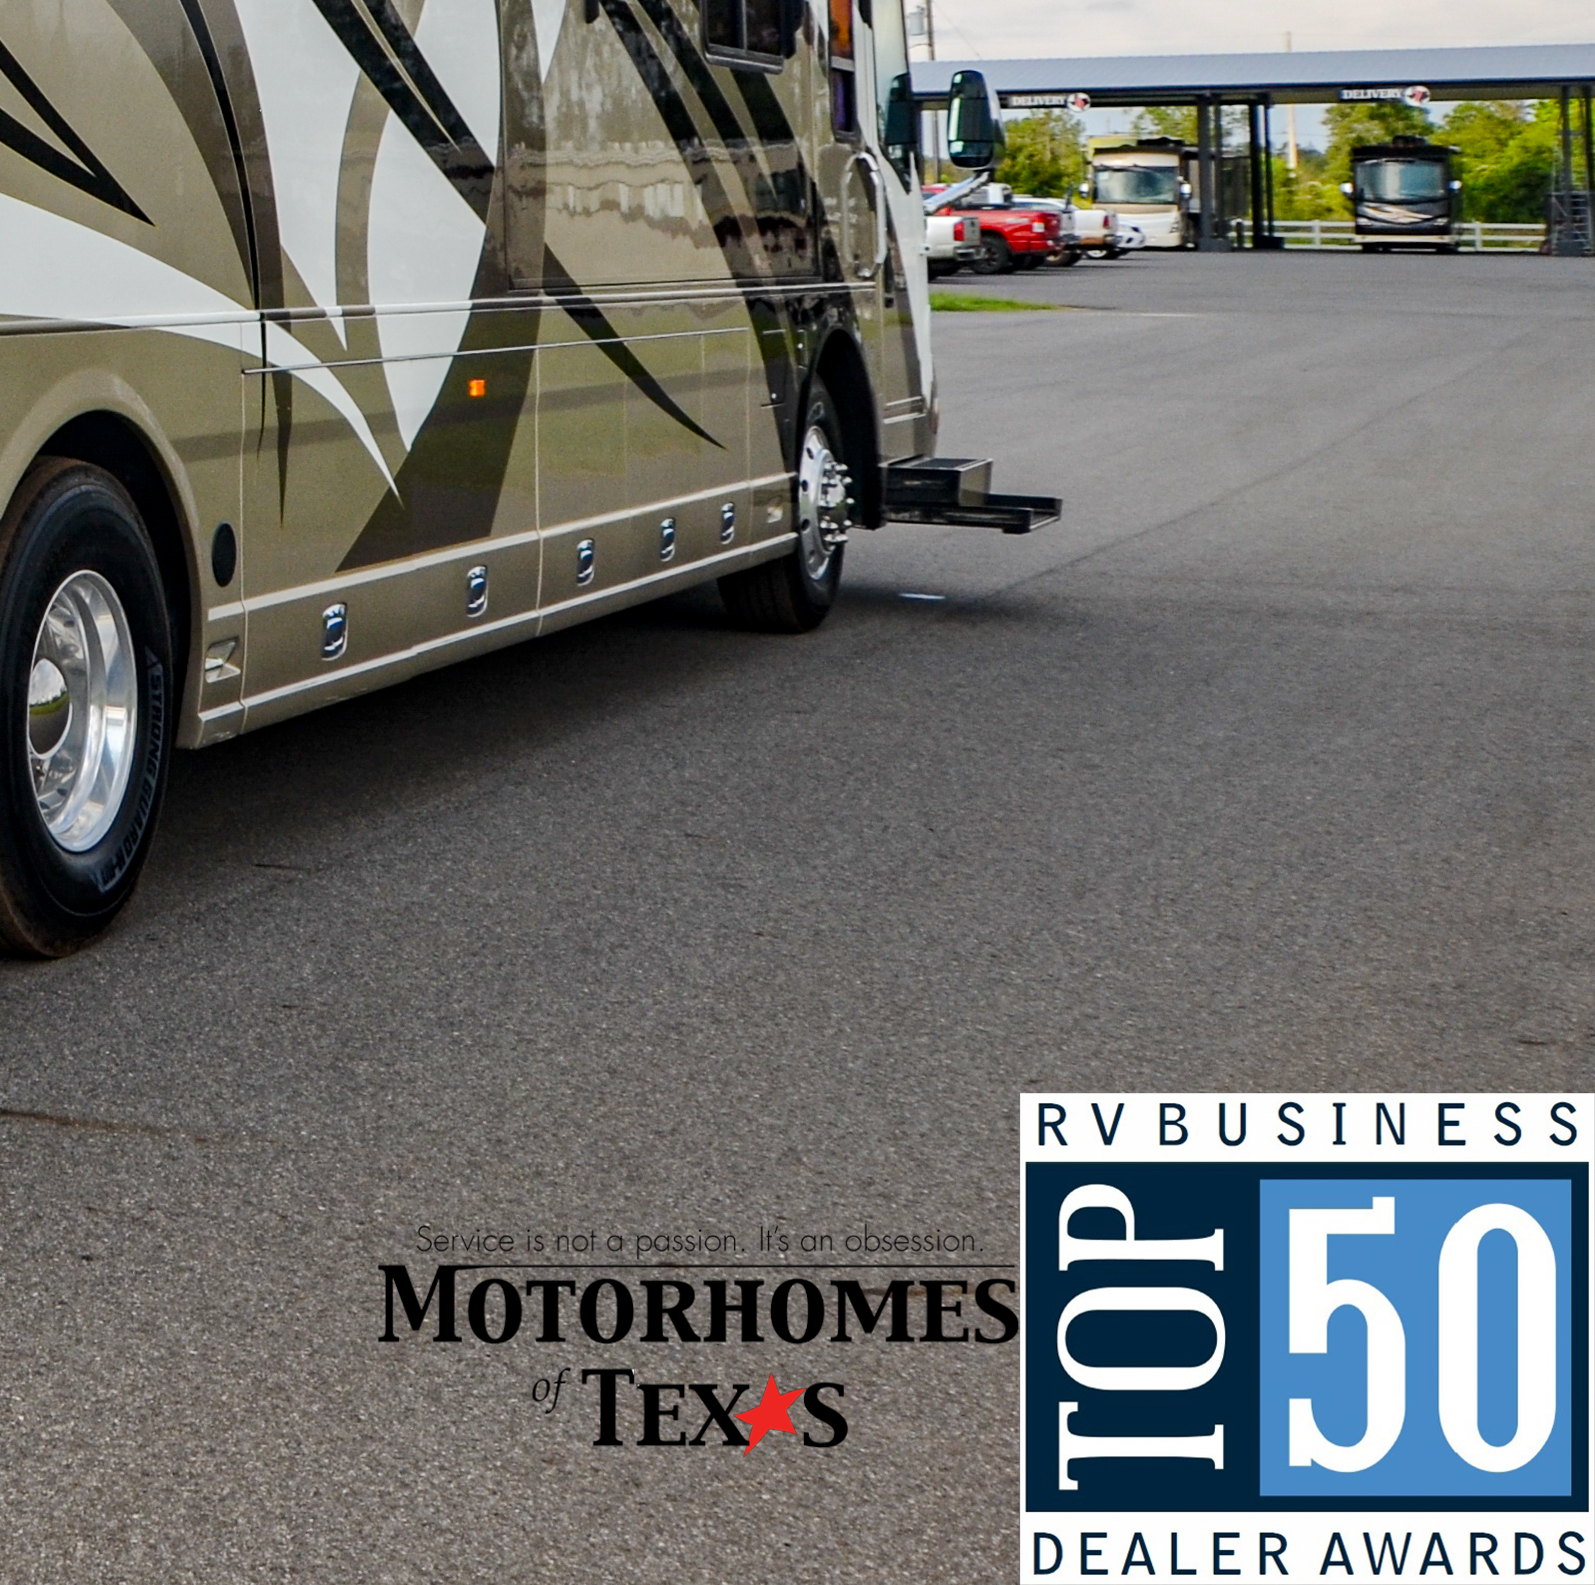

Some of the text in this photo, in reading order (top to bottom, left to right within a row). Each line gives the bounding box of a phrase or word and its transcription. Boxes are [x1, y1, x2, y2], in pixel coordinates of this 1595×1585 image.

[1341, 89, 1402, 99] DELIVERY
[1012, 96, 1065, 106] DELIVERY
[147, 674, 163, 778] STRONG
